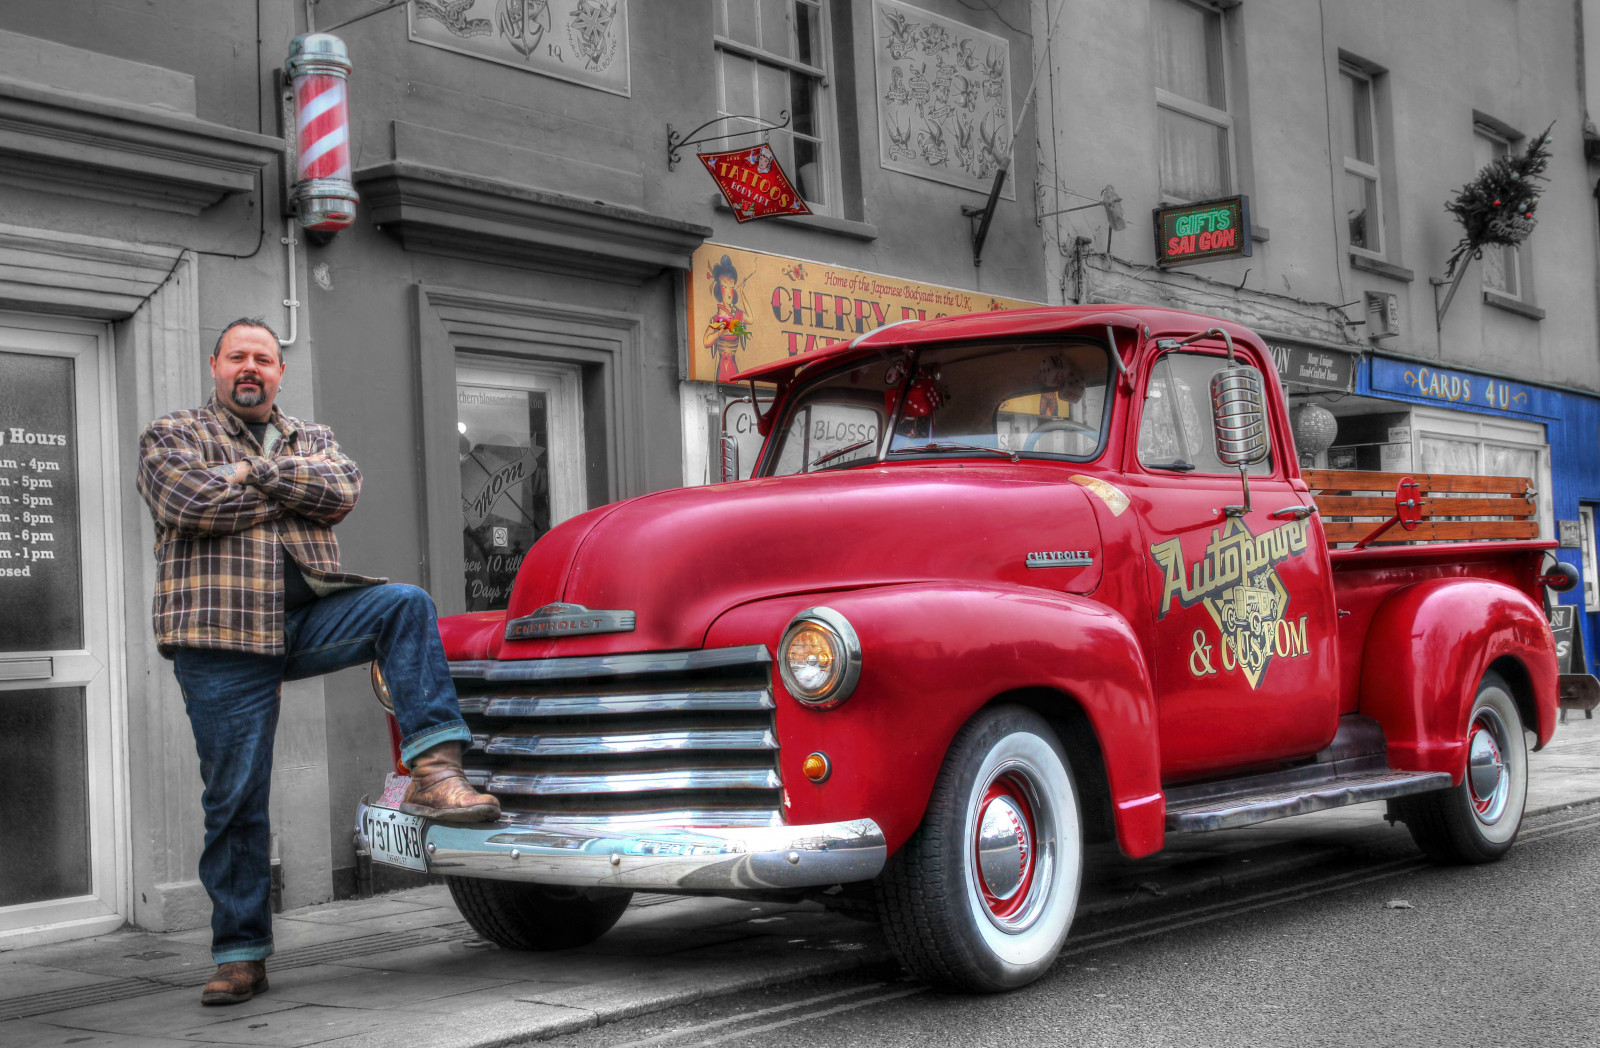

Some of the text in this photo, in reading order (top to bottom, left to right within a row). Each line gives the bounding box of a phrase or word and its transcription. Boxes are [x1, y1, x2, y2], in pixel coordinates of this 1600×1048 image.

[719, 162, 790, 208] TATTOOS
[731, 181, 755, 198] BODY
[753, 193, 771, 207] ART
[1175, 209, 1231, 237] GIFTS
[1167, 228, 1236, 256] SAI GON
[824, 271, 848, 288] Home
[850, 275, 859, 293] of
[859, 276, 870, 292] the
[870, 280, 903, 299] Japanese
[903, 285, 934, 305] Bodysuit
[935, 291, 943, 304] in
[943, 291, 955, 306] the
[771, 286, 891, 334] CHERRY
[1418, 367, 1472, 401] CARDS
[10, 428, 67, 446] Hours
[814, 420, 878, 442] BLOSSO
[29, 458, 60, 472] 4pm
[22, 475, 53, 490] 5pm
[22, 494, 53, 508] 5pm
[23, 511, 54, 526] 8pm
[487, 554, 502, 572] 10
[1027, 551, 1090, 560] CHEVROLET
[0, 565, 31, 577] osed
[1151, 520, 1310, 615] Autopower
[472, 579, 501, 604] Days
[515, 619, 602, 635] CHEVROLET
[1190, 616, 1309, 677] & CUSTOM
